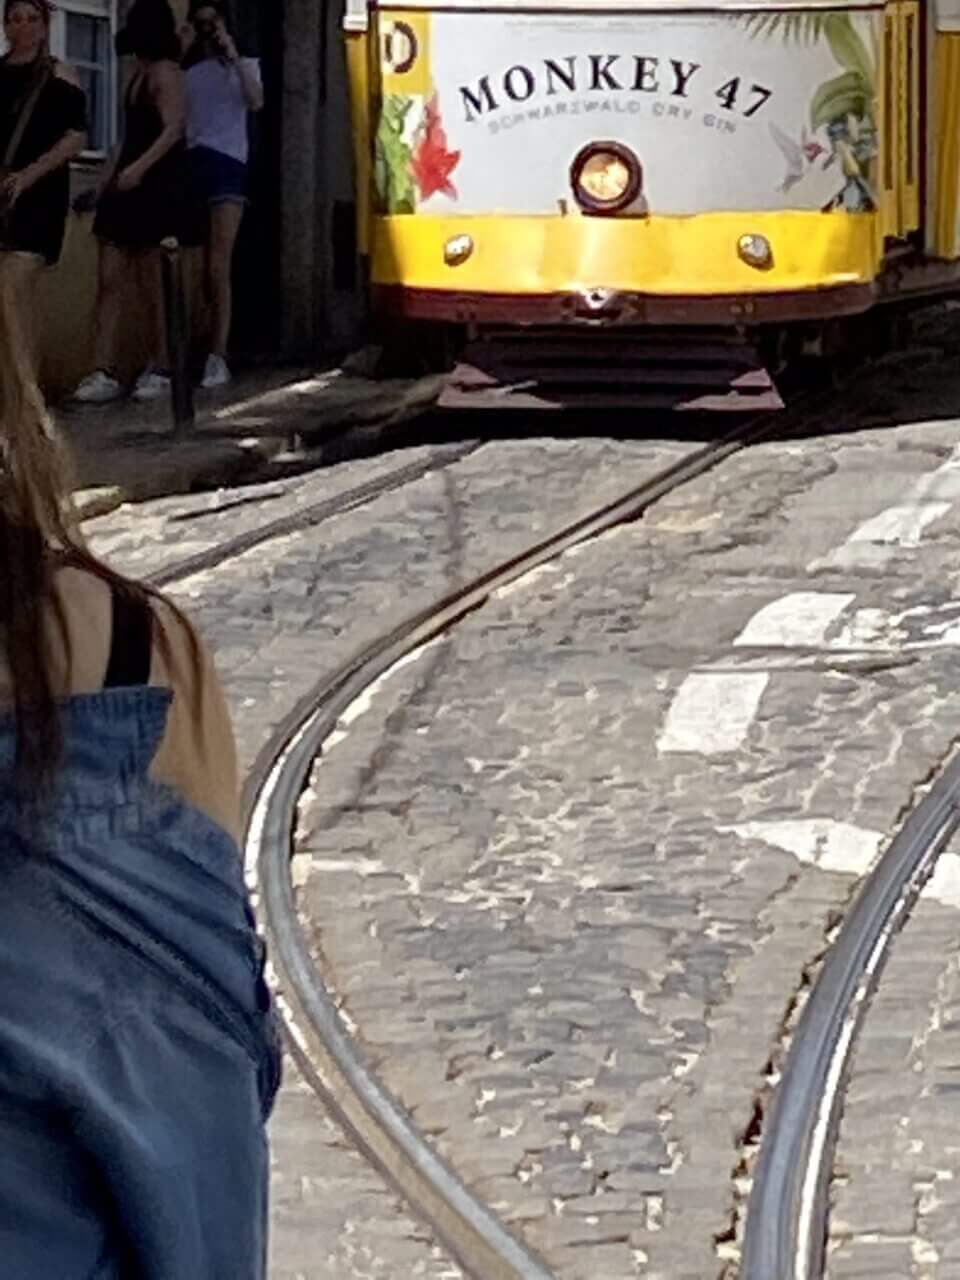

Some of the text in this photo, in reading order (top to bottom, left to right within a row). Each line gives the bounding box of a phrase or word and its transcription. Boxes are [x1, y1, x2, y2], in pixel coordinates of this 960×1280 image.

[459, 54, 773, 122] MONKEY 47
[652, 102, 693, 120] DRY
[703, 112, 737, 135] GIN
